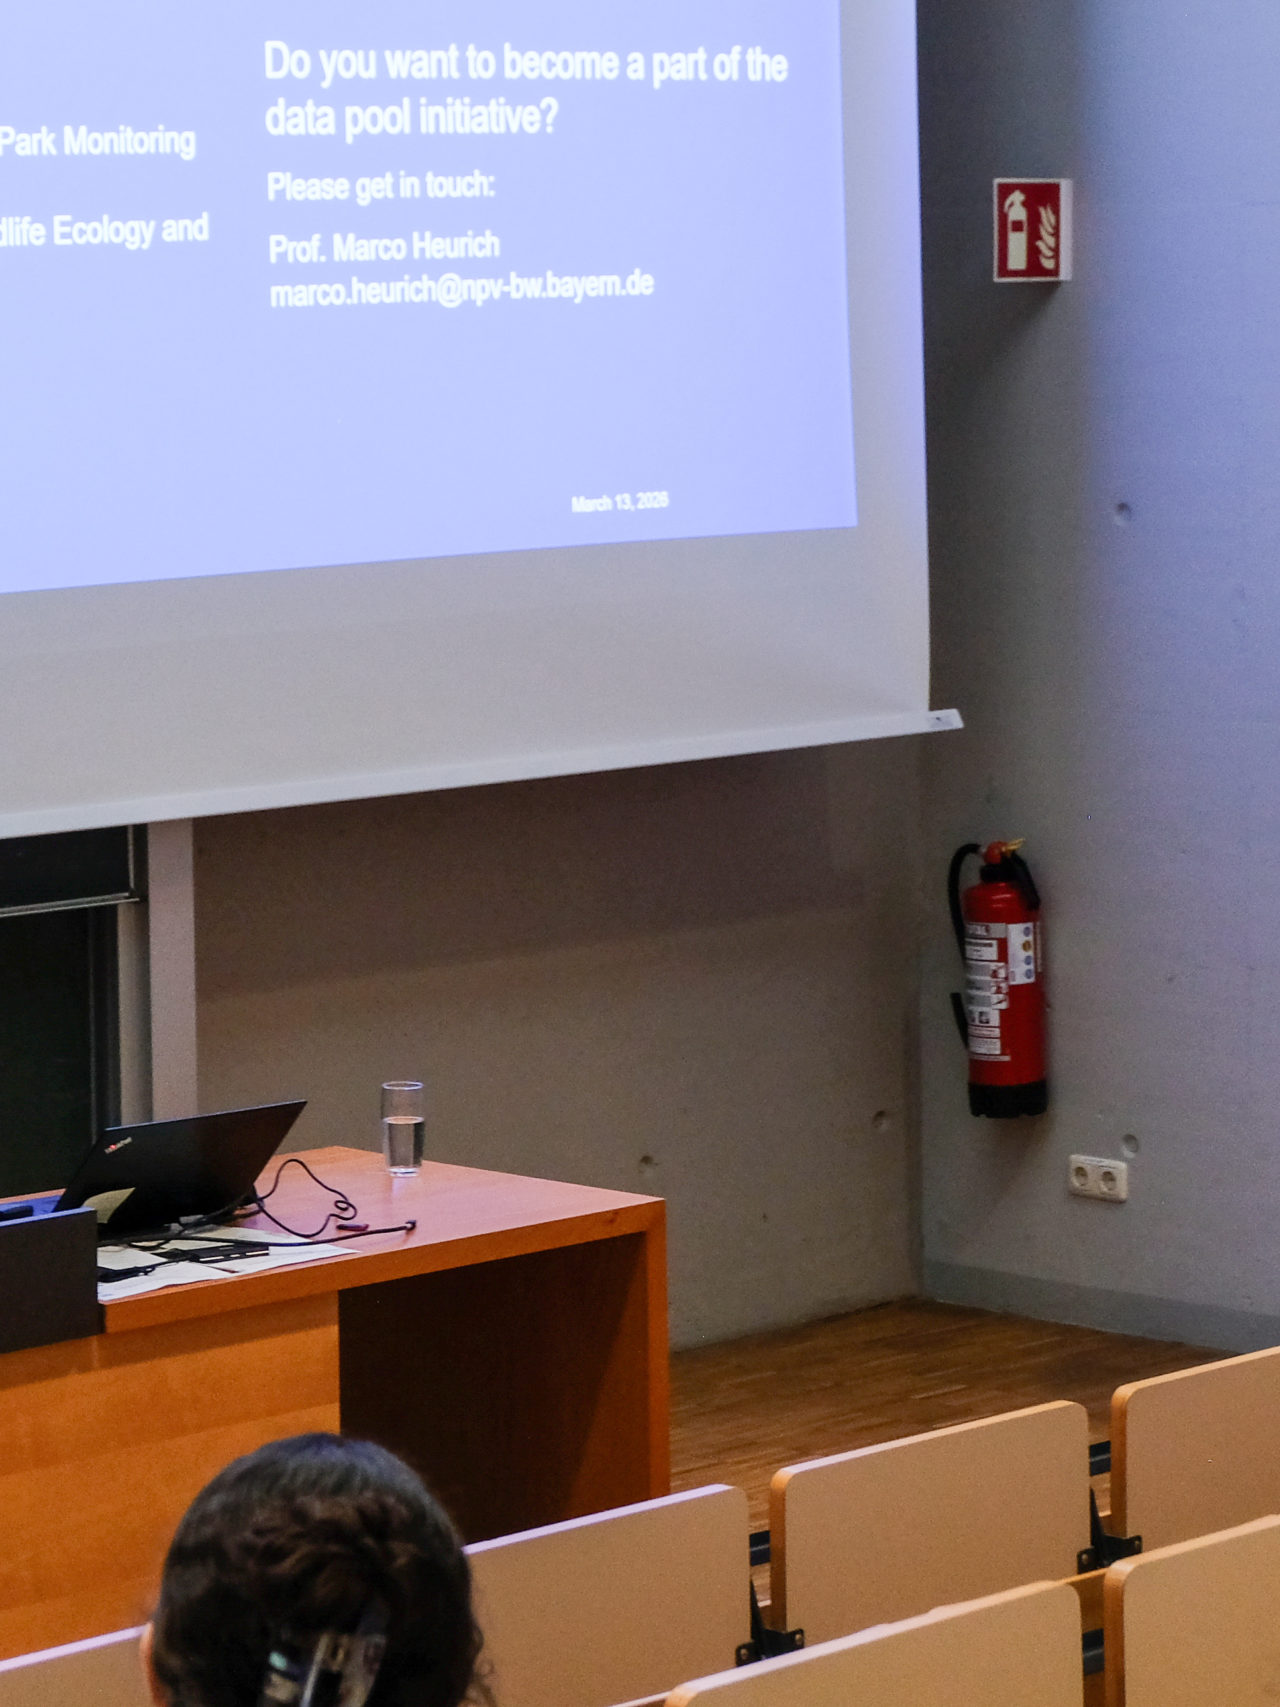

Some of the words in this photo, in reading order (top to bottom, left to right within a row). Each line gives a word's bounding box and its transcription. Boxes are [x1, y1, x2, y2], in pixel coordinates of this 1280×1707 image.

[265, 40, 311, 79] Do
[319, 50, 376, 88] you
[384, 43, 460, 79] want
[466, 44, 496, 79] to
[504, 42, 620, 80] become
[627, 52, 645, 80] a
[653, 47, 707, 89] part
[713, 45, 742, 81] of
[746, 46, 789, 82] the
[265, 97, 335, 135] data
[345, 97, 410, 144] pool
[420, 97, 559, 134] initiative?
[0, 126, 57, 156] Park
[64, 125, 196, 160] Monitoring
[268, 172, 350, 200] Please
[356, 172, 394, 206] get
[400, 171, 420, 198] in
[425, 169, 495, 198] touch:
[53, 214, 156, 250] Ecology
[162, 212, 209, 242] and
[269, 234, 326, 263] Prof.
[333, 233, 407, 261] Marco
[413, 229, 500, 259] Heurich
[270, 268, 654, 308] marco.heurich@npv-bw.bayern.de
[572, 495, 613, 512] March
